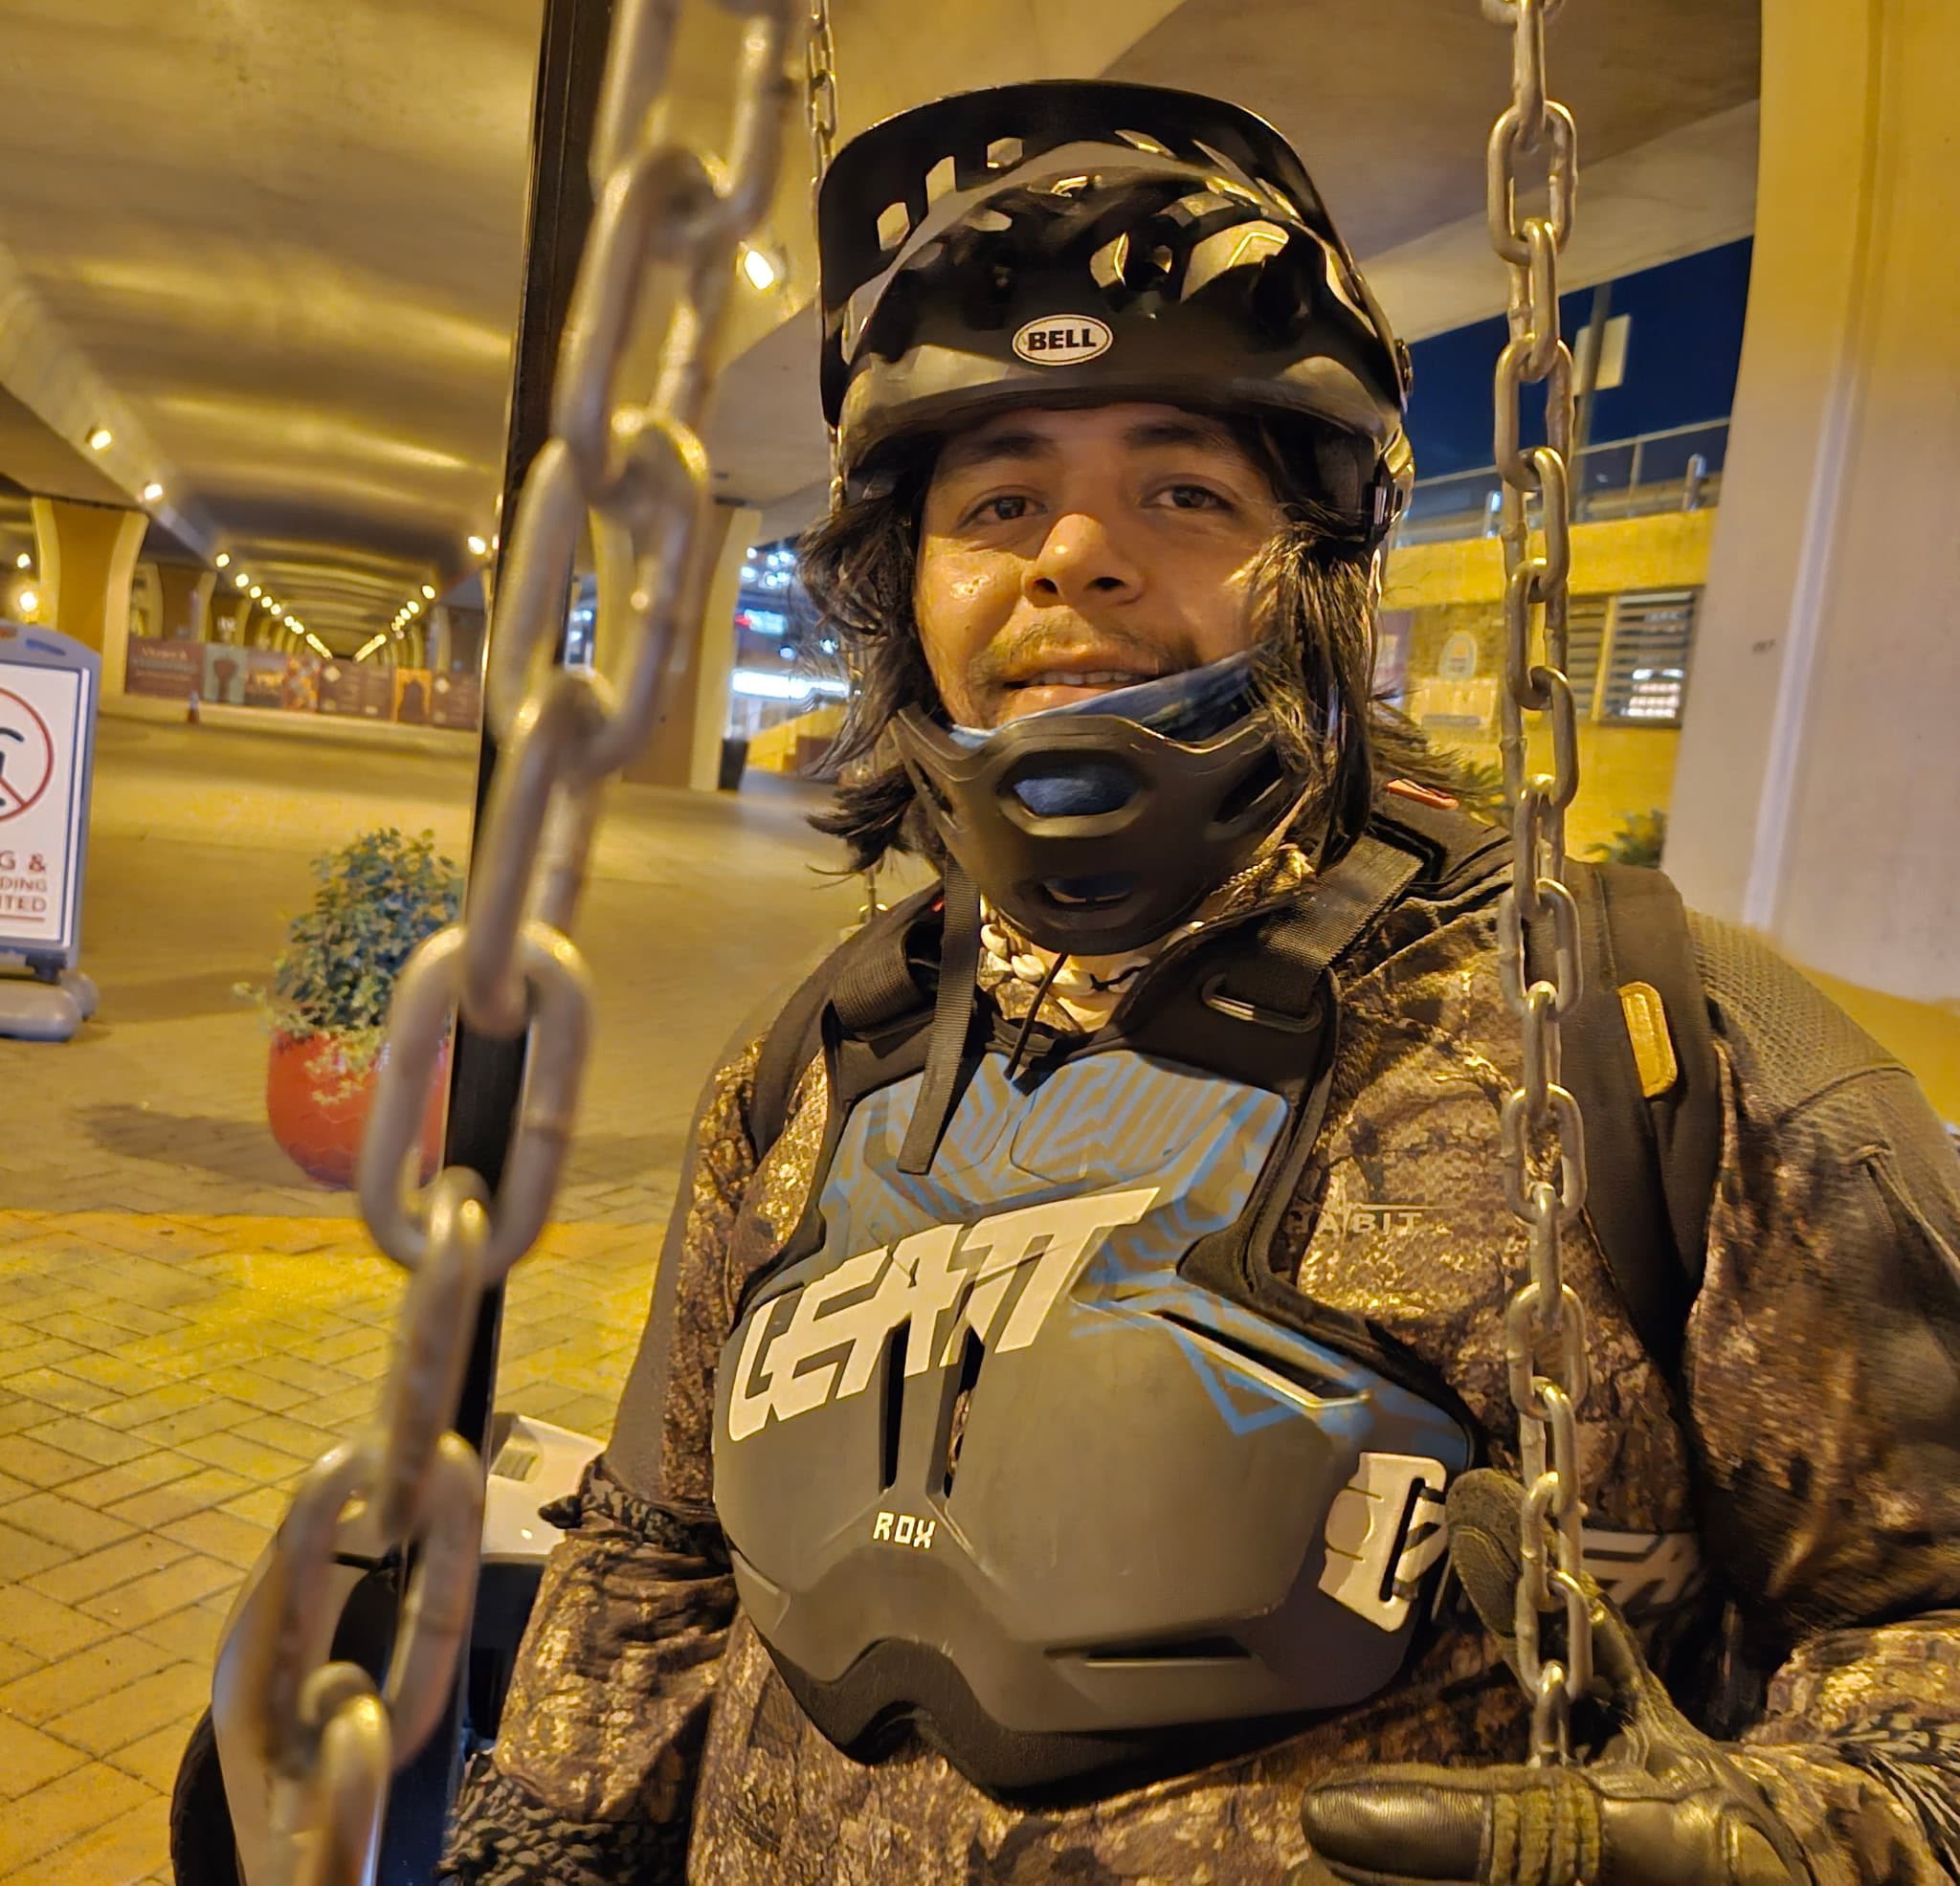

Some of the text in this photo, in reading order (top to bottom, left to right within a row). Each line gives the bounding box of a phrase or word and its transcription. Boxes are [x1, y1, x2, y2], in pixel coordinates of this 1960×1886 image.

[1027, 328, 1097, 351] BELL
[29, 853, 46, 873] &
[728, 1187, 1160, 1441] LEATT
[873, 1512, 936, 1548] ROX
